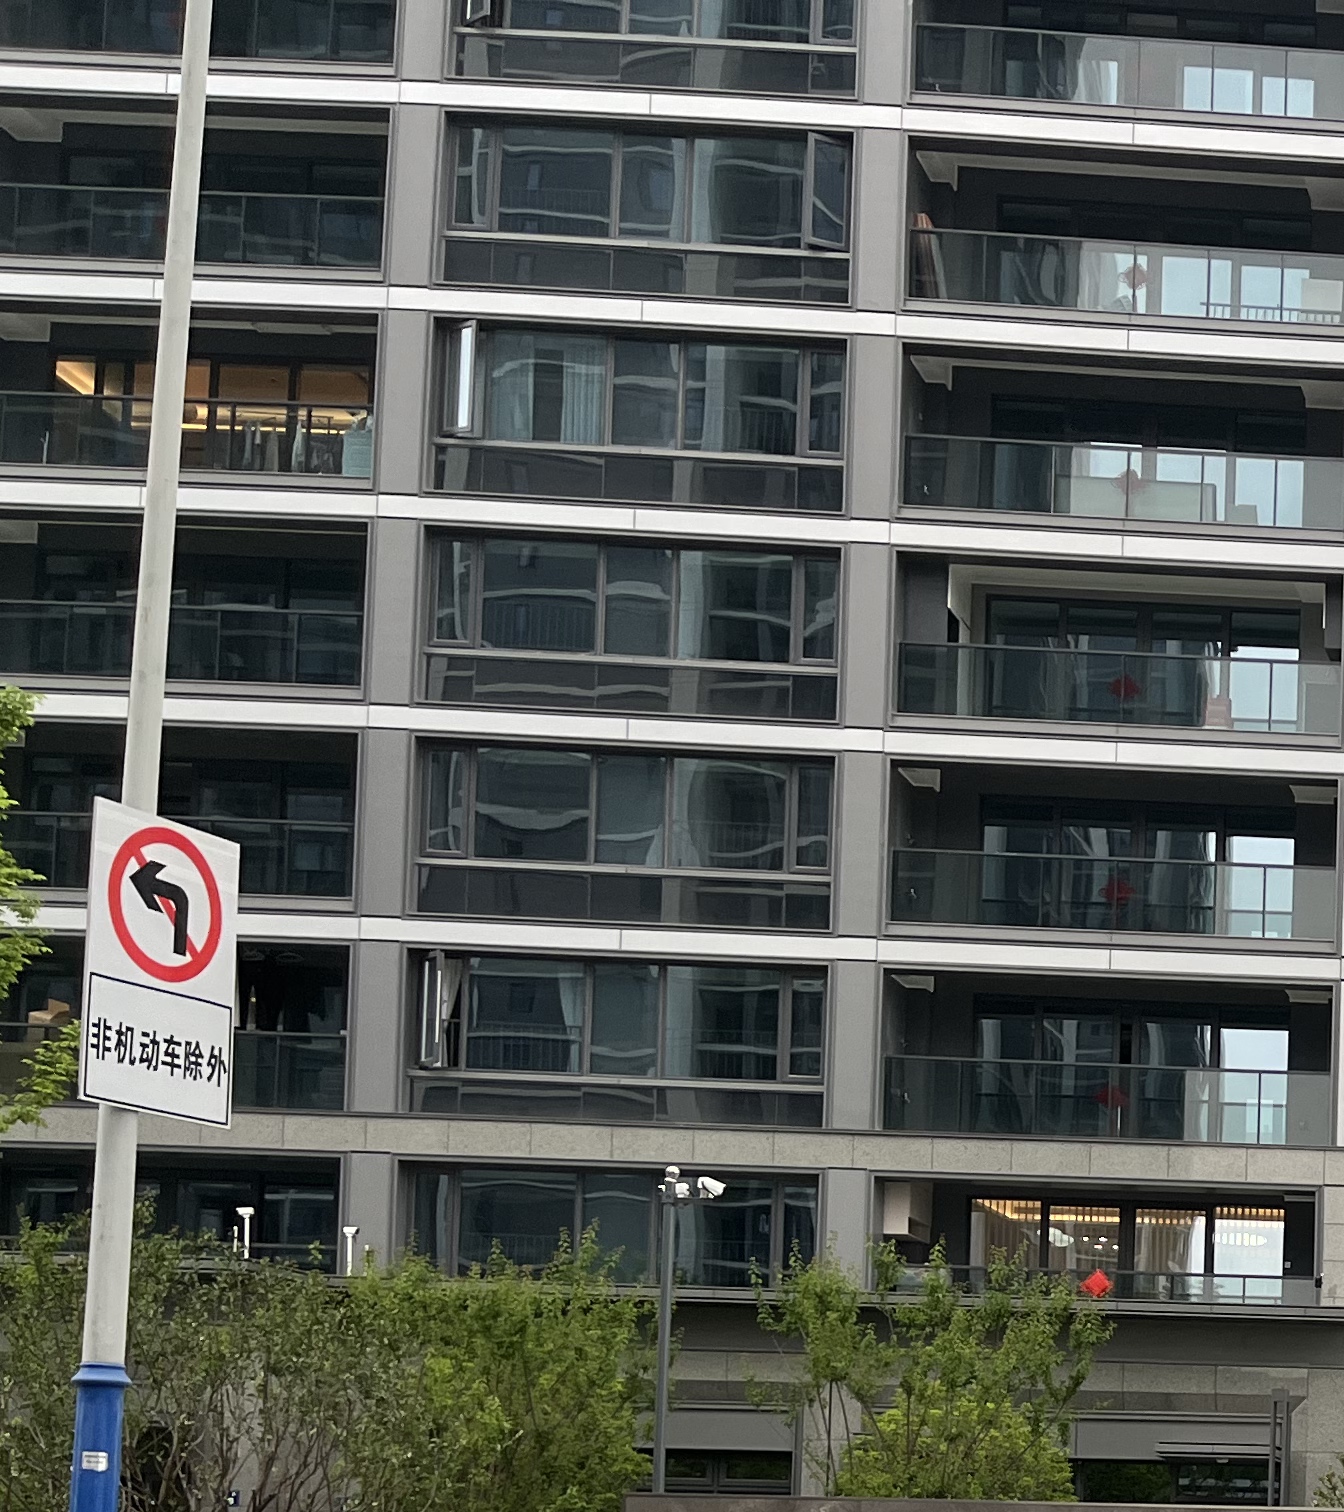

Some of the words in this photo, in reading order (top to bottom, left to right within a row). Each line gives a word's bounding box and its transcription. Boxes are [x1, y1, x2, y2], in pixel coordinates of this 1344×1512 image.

[90, 1016, 227, 1087] 非机动车除外
